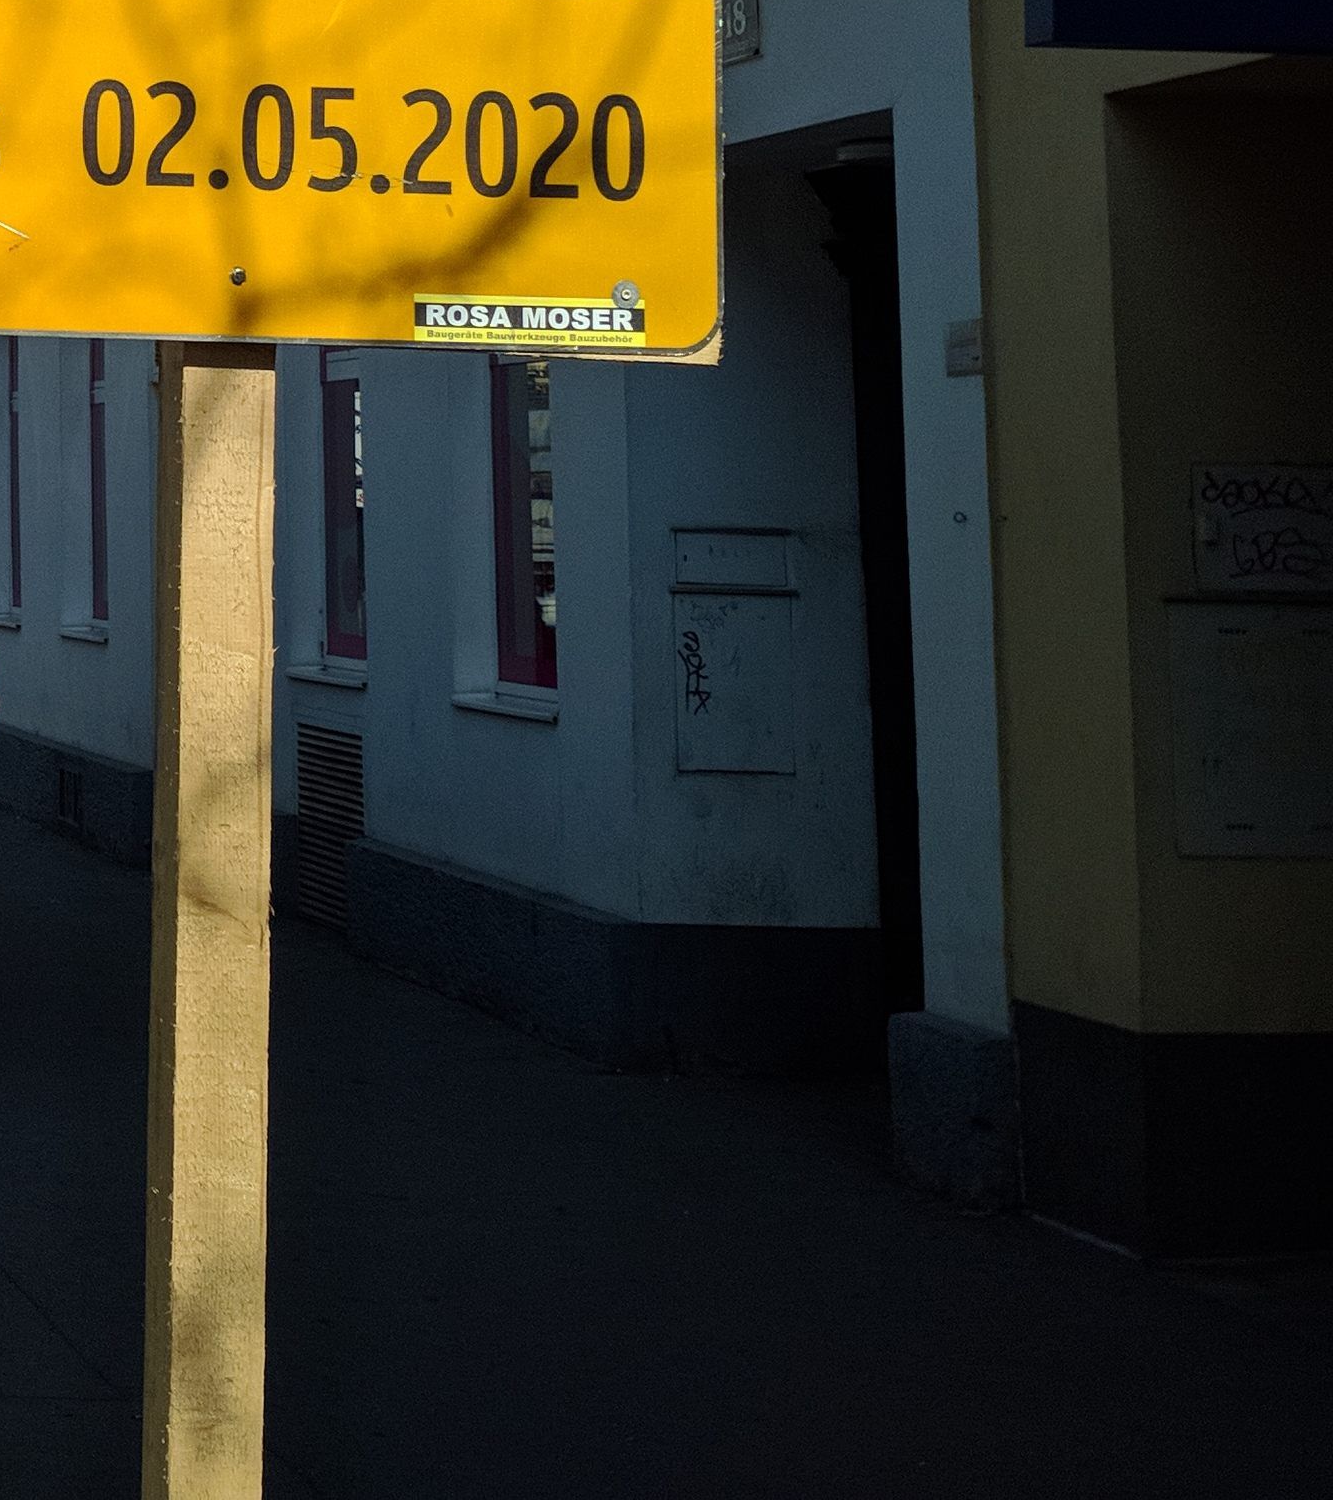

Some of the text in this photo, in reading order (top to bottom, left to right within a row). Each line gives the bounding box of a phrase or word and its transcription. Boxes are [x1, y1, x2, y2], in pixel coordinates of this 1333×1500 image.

[81, 78, 647, 203] 02.05.2020
[425, 304, 634, 332] ROSA MOSER
[426, 329, 633, 344] Baugeräte Bauwerkzeuge Bauzubehör
